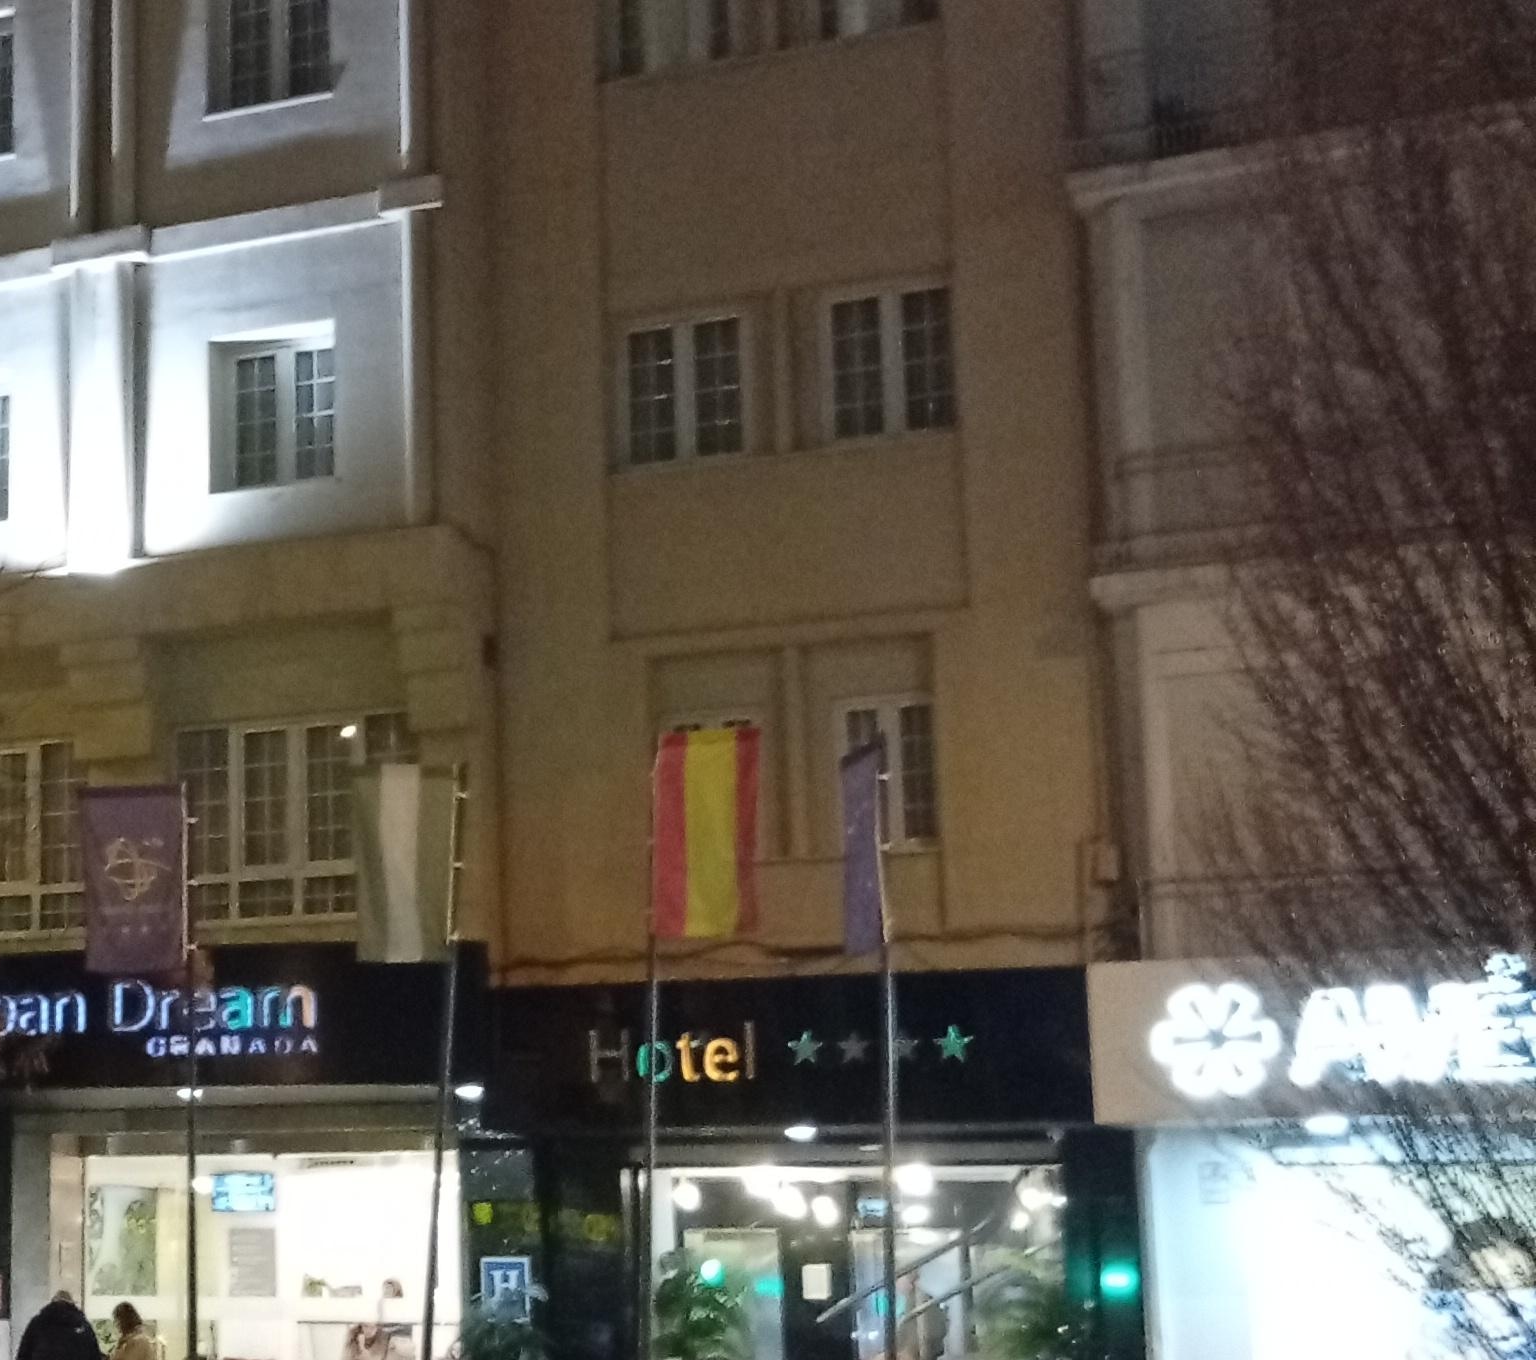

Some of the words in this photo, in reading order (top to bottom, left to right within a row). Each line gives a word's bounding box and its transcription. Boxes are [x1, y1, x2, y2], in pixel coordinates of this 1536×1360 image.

[113, 979, 318, 1032] Dream
[146, 1035, 319, 1057] GRANADA
[589, 1021, 756, 1082] Hotel
